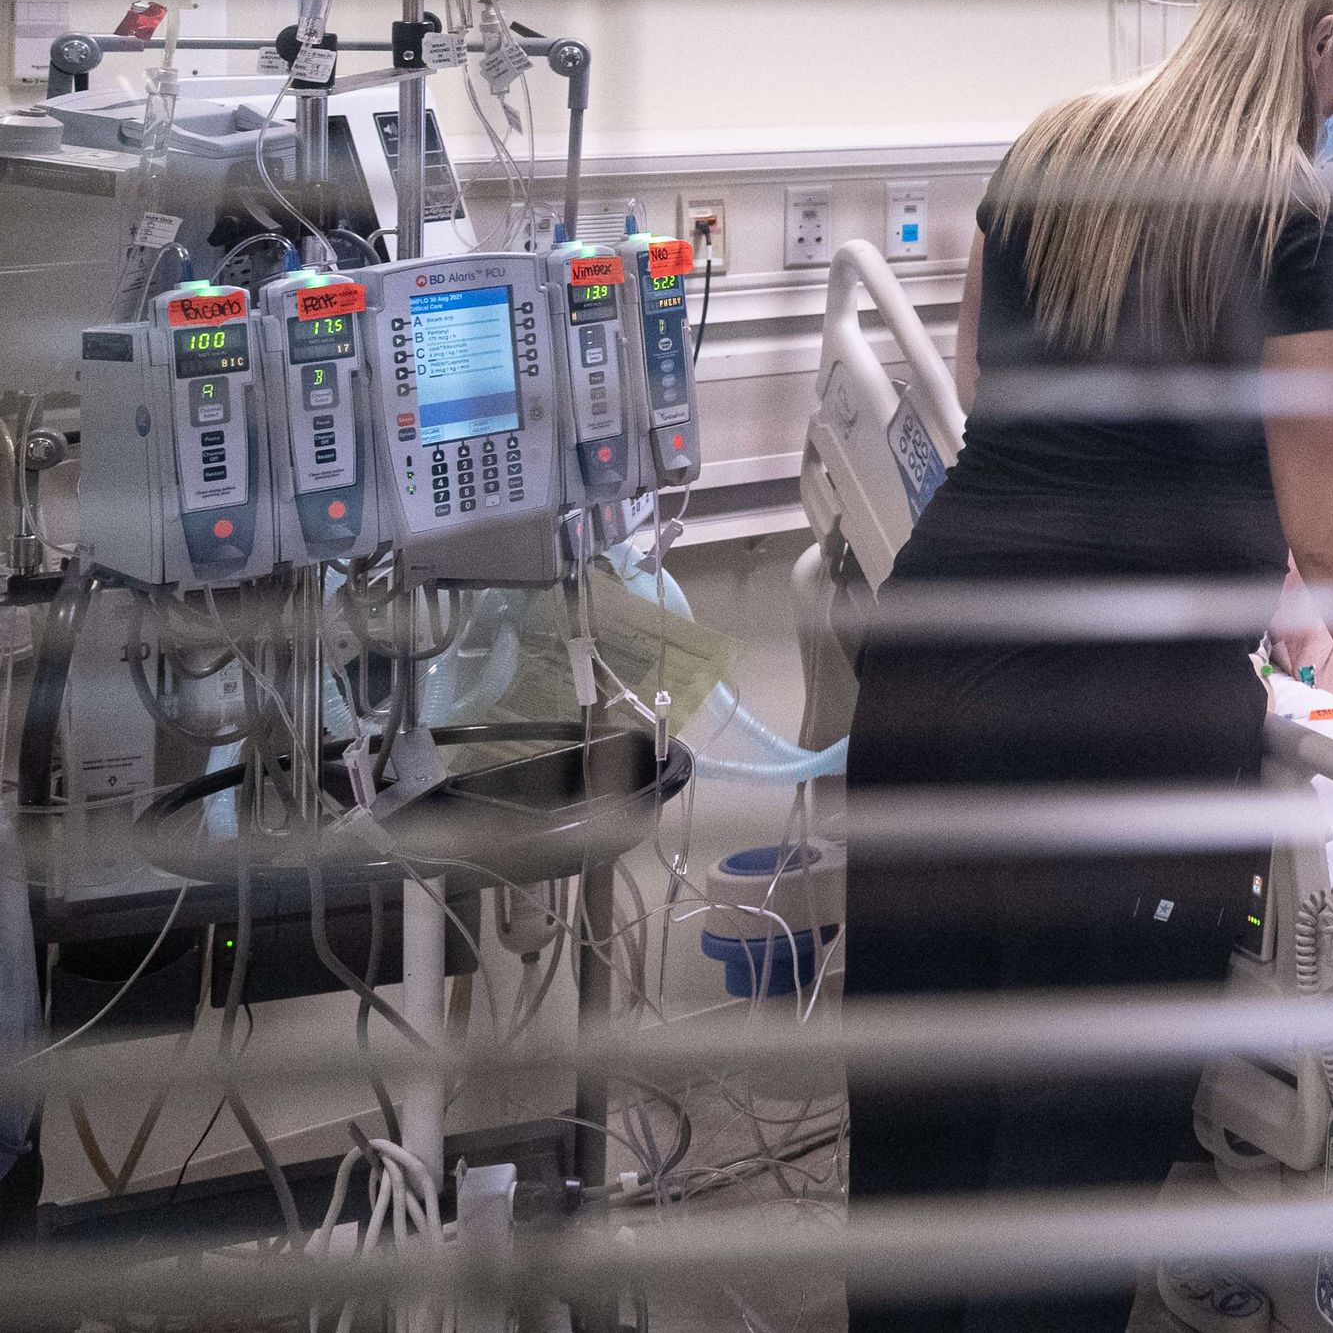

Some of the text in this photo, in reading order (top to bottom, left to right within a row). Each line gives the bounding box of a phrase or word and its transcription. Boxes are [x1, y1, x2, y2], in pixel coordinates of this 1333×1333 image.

[650, 248, 669, 262] Neo
[430, 274, 445, 285] BD
[486, 267, 506, 278] PCU
[572, 264, 612, 281] Nimbex
[653, 275, 675, 291] 52.2
[585, 285, 608, 300] 13.9
[181, 299, 242, 321] Bicarb
[413, 316, 422, 327] A
[190, 331, 226, 351] 100
[415, 333, 424, 343] B
[337, 343, 350, 354] 17
[416, 348, 425, 358] C
[221, 357, 244, 368] BIC
[417, 365, 427, 375] D
[462, 461, 467, 469] 2
[487, 456, 493, 464] 3
[437, 465, 442, 474] 1
[488, 469, 494, 477] 6
[437, 478, 443, 487] 4
[464, 474, 469, 482] 5
[465, 487, 470, 496] 8
[489, 482, 495, 491] 9
[439, 491, 444, 500] 7
[465, 500, 471, 509] 0
